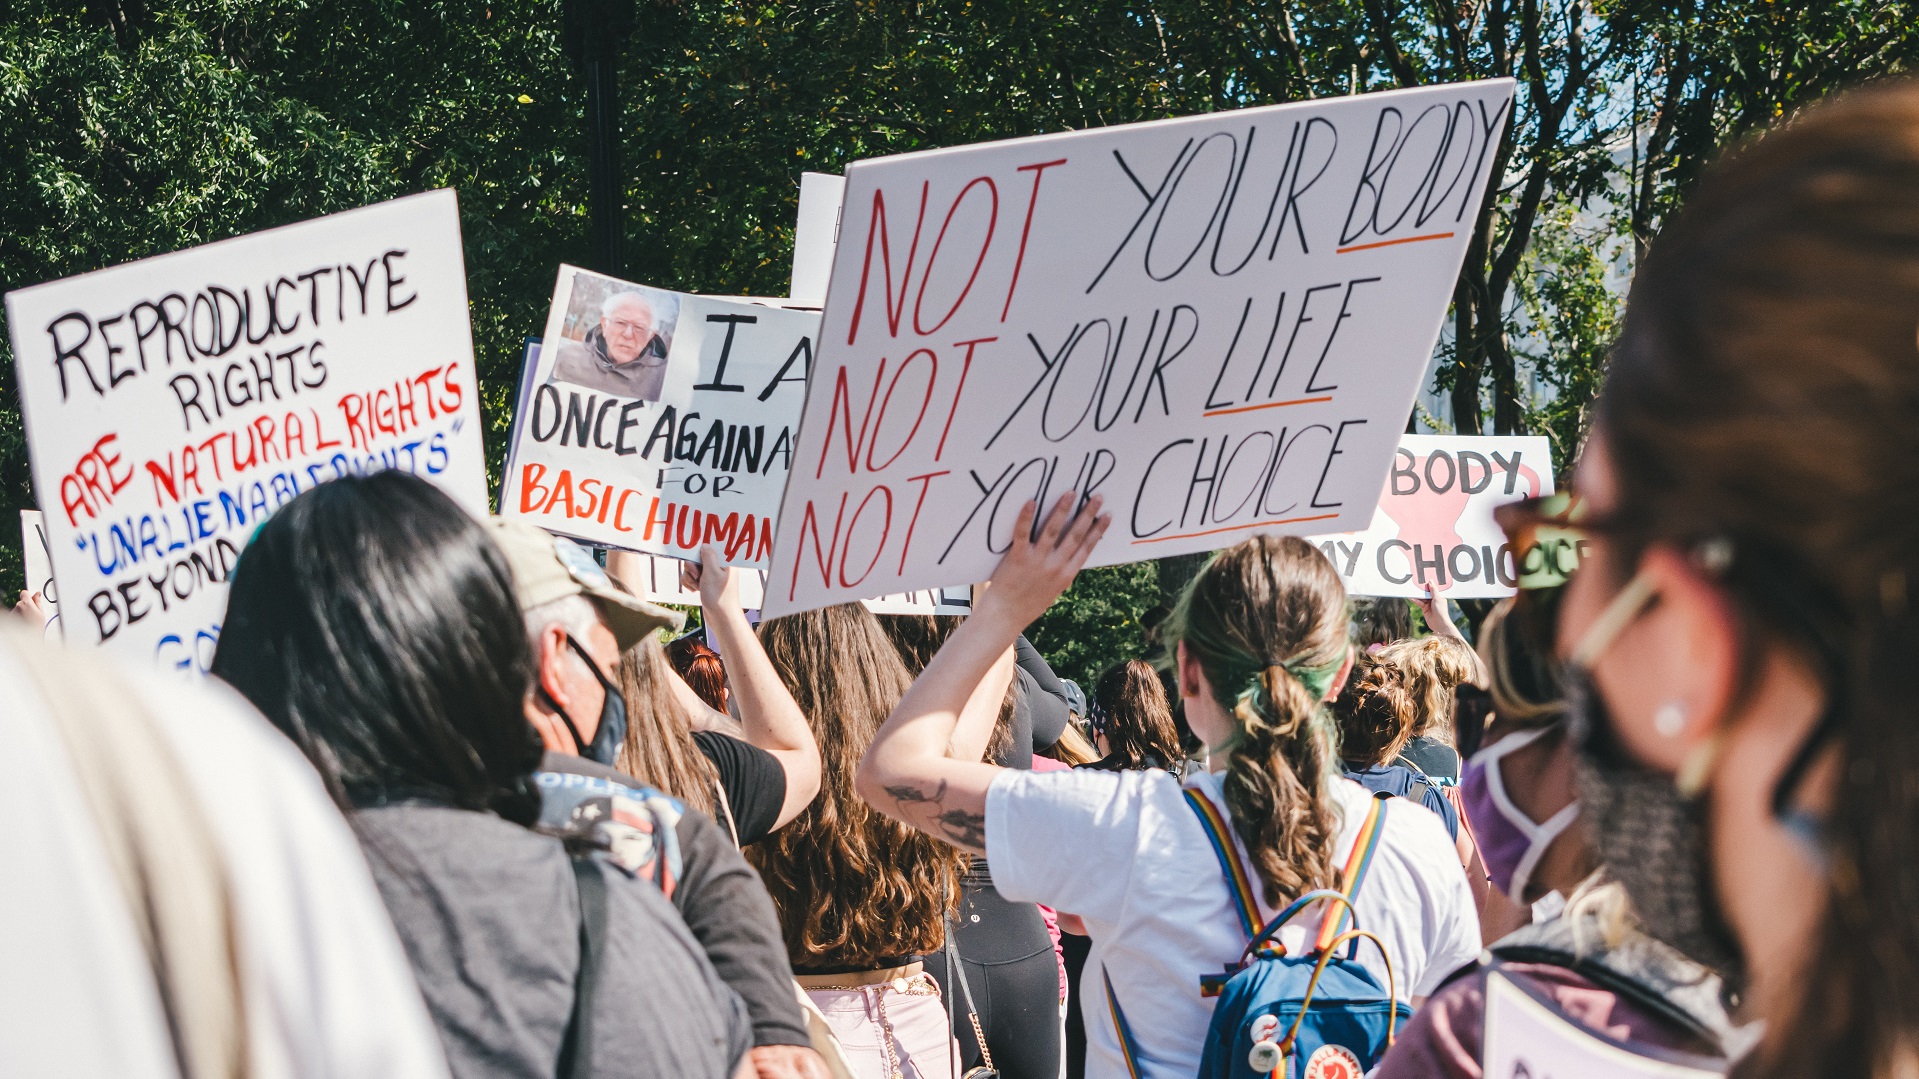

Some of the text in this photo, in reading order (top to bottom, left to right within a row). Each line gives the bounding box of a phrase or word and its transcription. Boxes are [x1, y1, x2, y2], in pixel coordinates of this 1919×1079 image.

[848, 96, 1512, 345] NOT YOUR BODY
[46, 250, 419, 401] REPRODUCTIVE
[693, 313, 757, 392] I
[169, 341, 329, 431] RIGHTS
[816, 277, 1382, 480] NOT YOUR LIFE
[60, 361, 464, 528] ARE NATURAL RIGHTS
[530, 383, 798, 477] ONCE AGAIN A
[1391, 447, 1522, 495] BODY
[519, 463, 773, 563] BASIC HUMAN
[656, 468, 744, 497] FOR
[790, 419, 1367, 601] NOT YOUR CHOICE
[88, 538, 238, 645] BEYOND
[153, 624, 222, 677] GO
